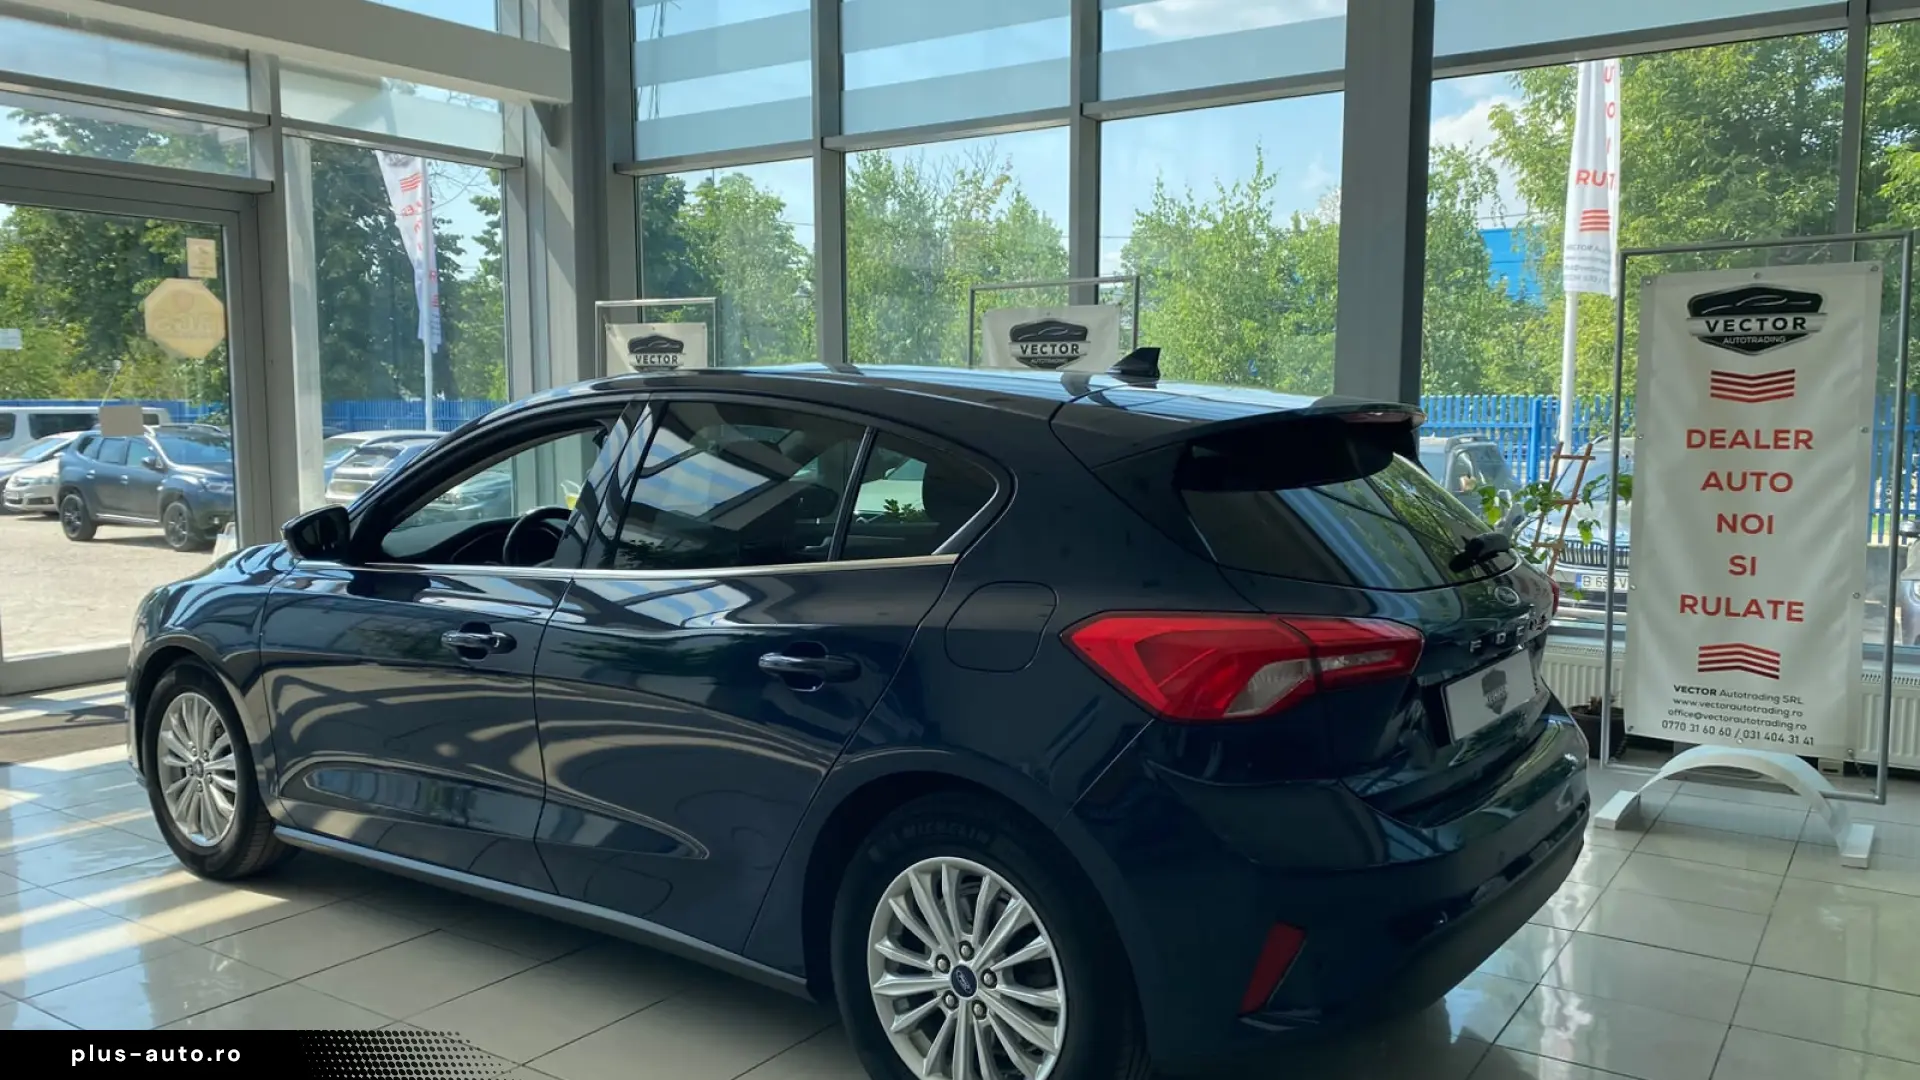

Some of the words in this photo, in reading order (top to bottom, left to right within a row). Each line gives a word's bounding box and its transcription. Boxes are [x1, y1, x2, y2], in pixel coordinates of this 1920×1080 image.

[1705, 316, 1807, 333] VECTOR
[1020, 343, 1080, 355] VECTOR
[1723, 336, 1786, 345] AUTOTRADING
[635, 354, 678, 365] VECTOR
[1686, 428, 1814, 450] DEALER
[1700, 471, 1793, 492] AUTO
[1717, 513, 1774, 535] NOI
[1728, 555, 1757, 576] SI
[1679, 594, 1805, 622] RULATE
[1673, 684, 1717, 696] VECTOR
[1719, 689, 1781, 705] Autotrading
[1782, 695, 1805, 705] SRL
[1673, 698, 1804, 719] www.vectorautotrading.ro
[1668, 709, 1807, 731] office@vectorautotrading.ro
[1662, 719, 1687, 732] 0770
[1689, 723, 1700, 733] 31
[1702, 725, 1716, 735] 60
[1718, 727, 1732, 737] 60
[1743, 729, 1760, 740] 031
[1764, 732, 1784, 743] 404
[1788, 734, 1799, 744] 31
[1803, 736, 1814, 746] 41
